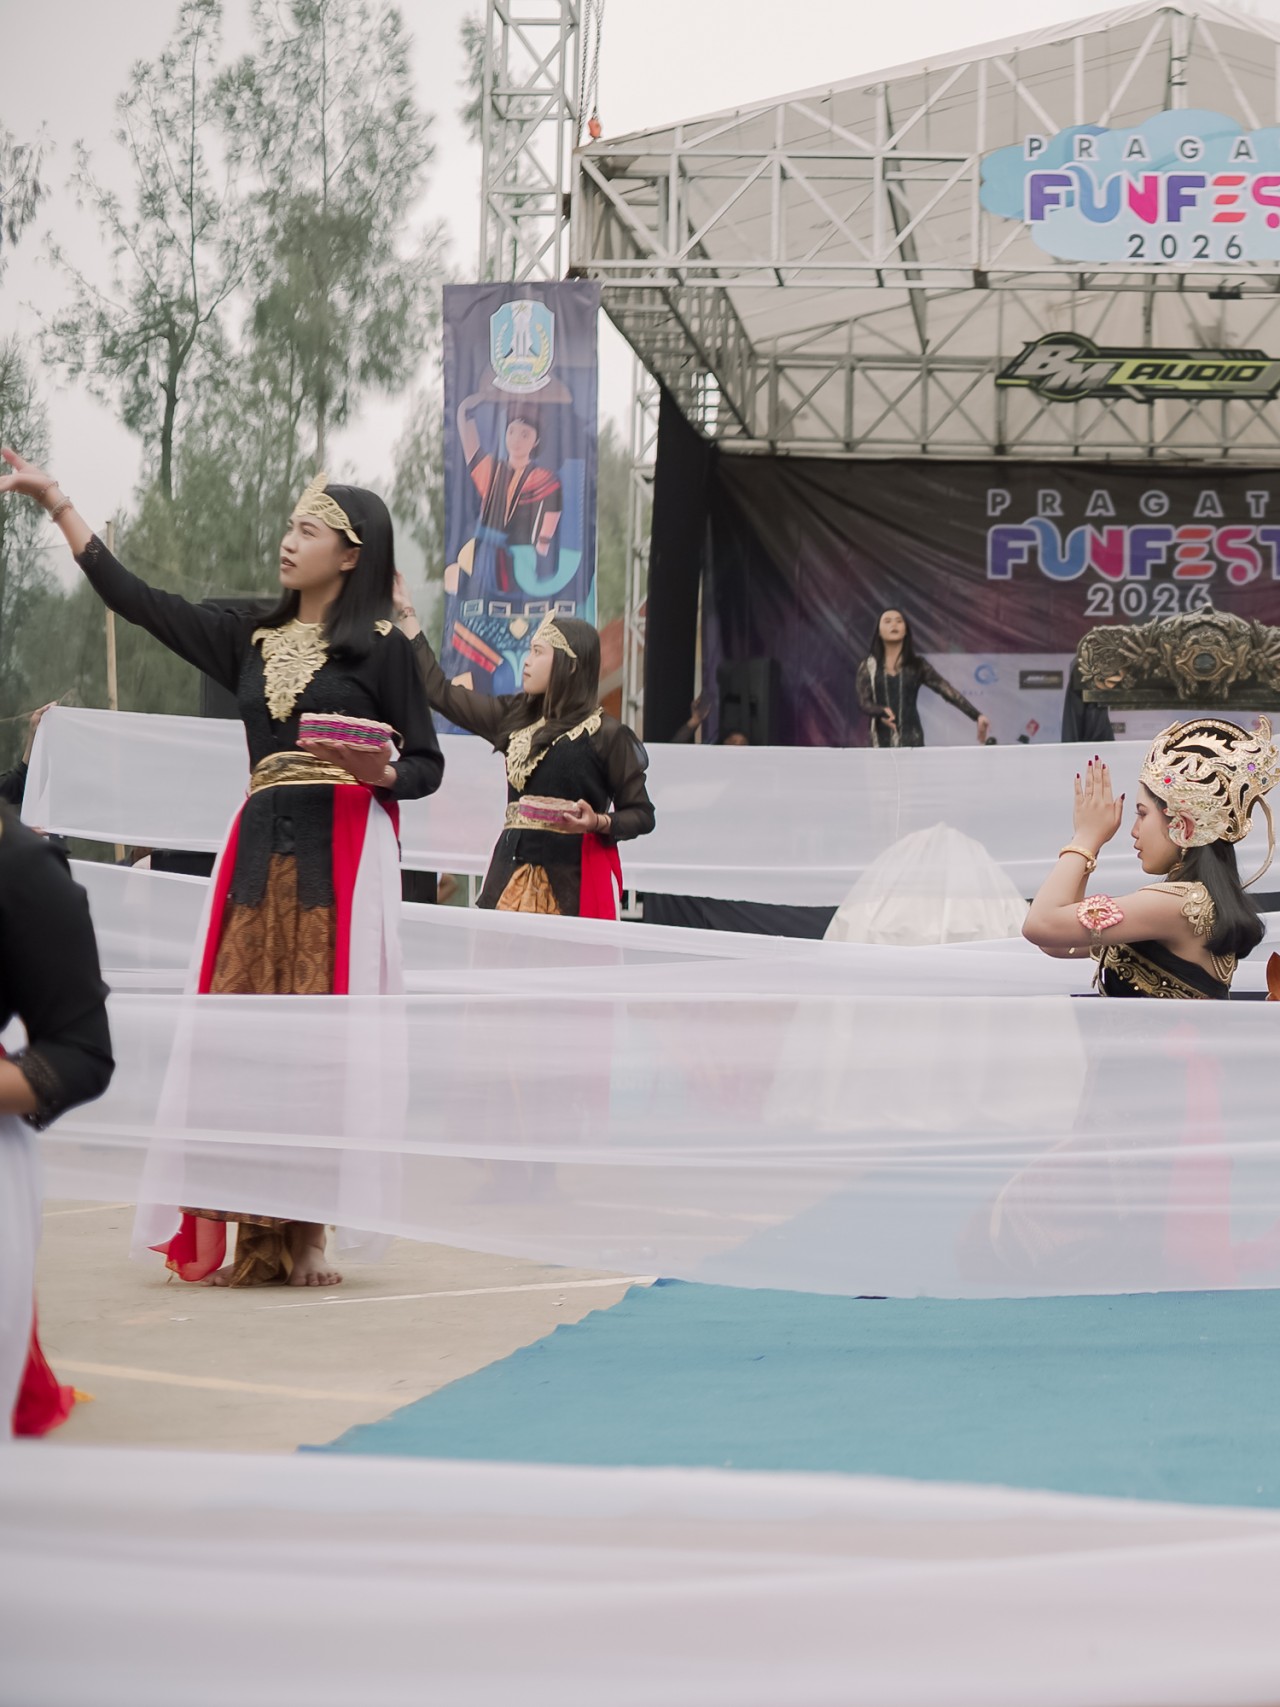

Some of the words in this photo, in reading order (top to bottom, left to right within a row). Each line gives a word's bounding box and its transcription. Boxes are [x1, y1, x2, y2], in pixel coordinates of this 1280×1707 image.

[1127, 233, 1243, 259] 2026
[1127, 362, 1268, 382] AUDIO
[1084, 583, 1213, 616] 2026
